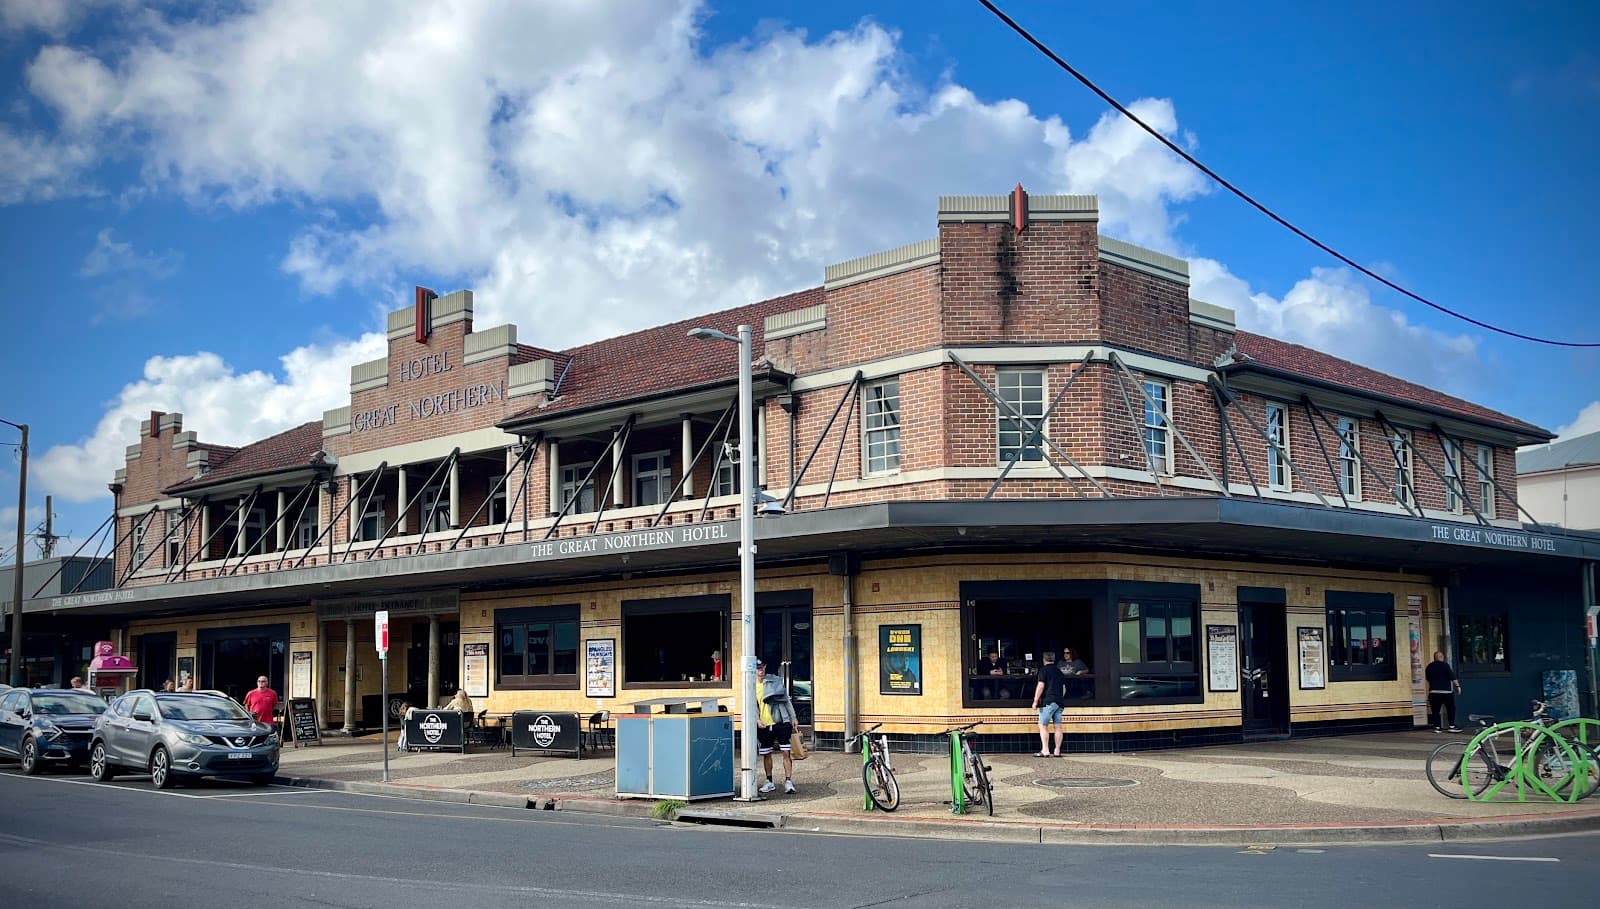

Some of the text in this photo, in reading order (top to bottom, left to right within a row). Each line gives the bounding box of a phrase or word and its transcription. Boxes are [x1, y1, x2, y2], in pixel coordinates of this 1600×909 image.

[400, 352, 453, 382] HOTEL
[354, 380, 503, 432] GREAT NORTHERN
[531, 525, 727, 557] THE GREAT NORTHERN HOTEL
[1432, 525, 1556, 551] THE GREAT NORTHERN HOTEL
[52, 590, 134, 607] THE GREAT NORTHERN HOTEL
